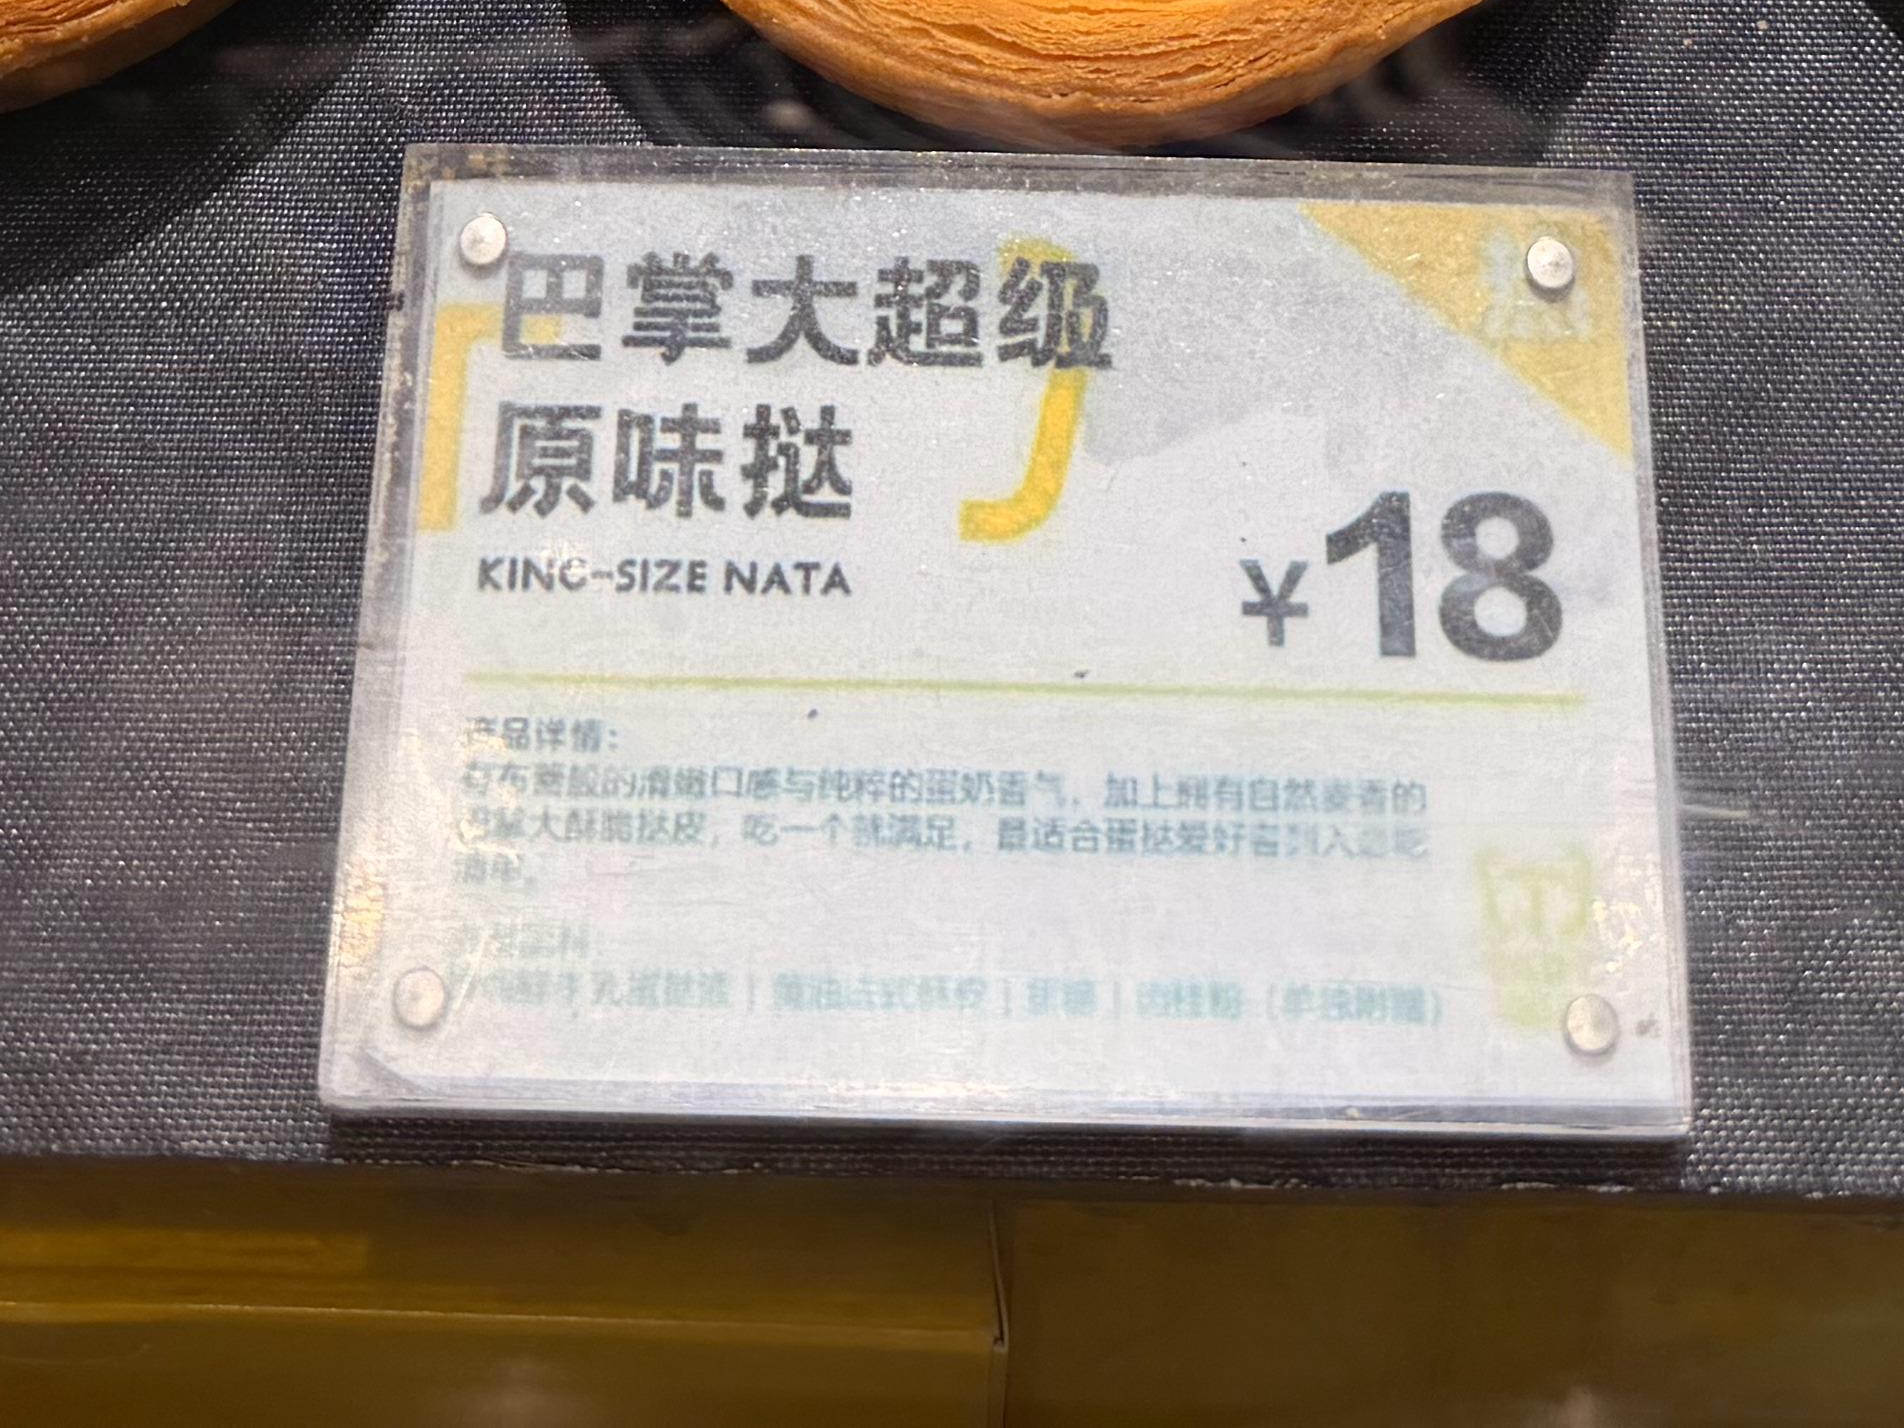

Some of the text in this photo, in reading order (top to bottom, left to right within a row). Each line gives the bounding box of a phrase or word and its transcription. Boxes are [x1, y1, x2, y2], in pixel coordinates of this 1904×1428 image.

[501, 250, 1113, 370] 巴掌大超级
[479, 401, 853, 519] 原味挞
[722, 560, 852, 596] NATA
